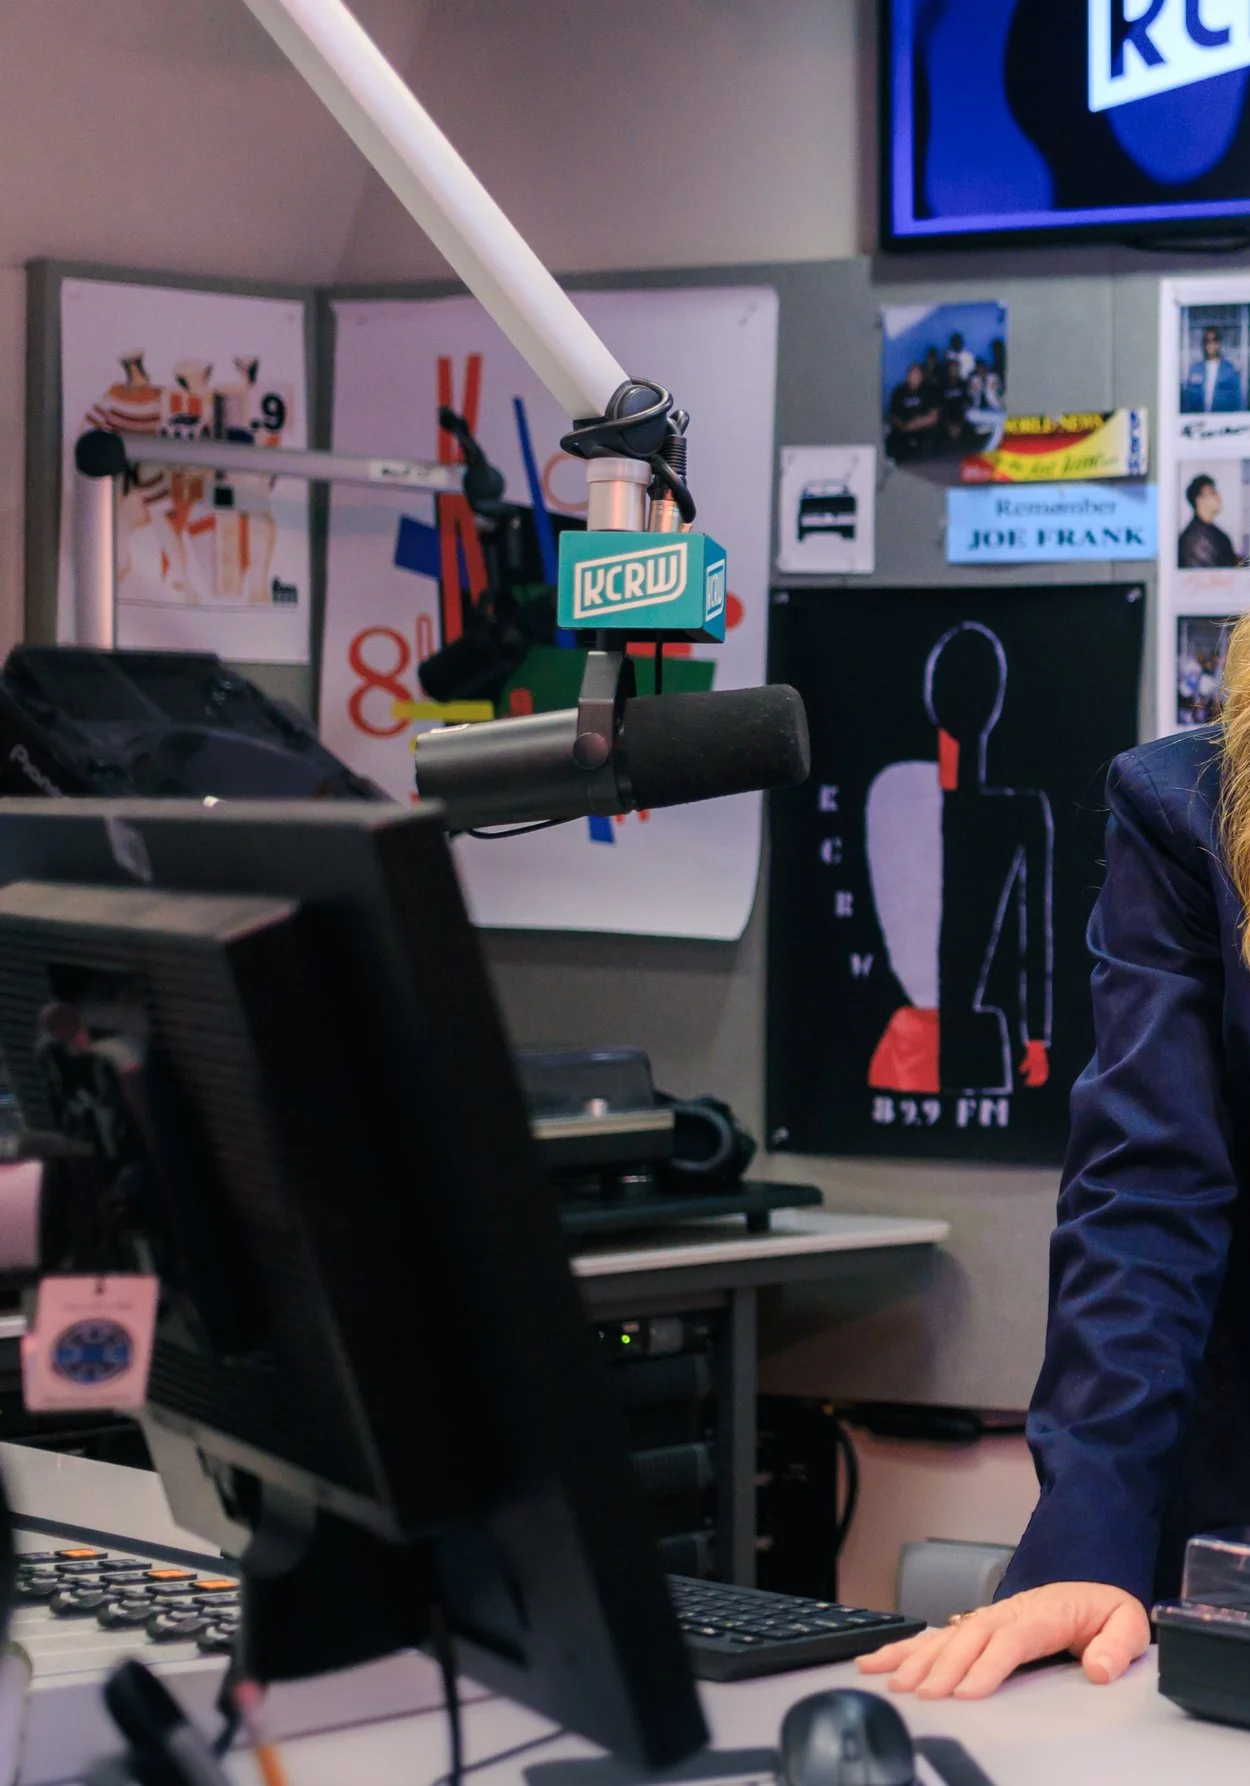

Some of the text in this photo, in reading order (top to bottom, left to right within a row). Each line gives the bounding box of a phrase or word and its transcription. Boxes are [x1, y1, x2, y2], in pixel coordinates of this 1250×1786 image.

[993, 499, 1117, 518] Remember
[968, 527, 1145, 551] JOE FRANK
[584, 555, 678, 607] KCRW
[956, 1098, 1011, 1128] FM
